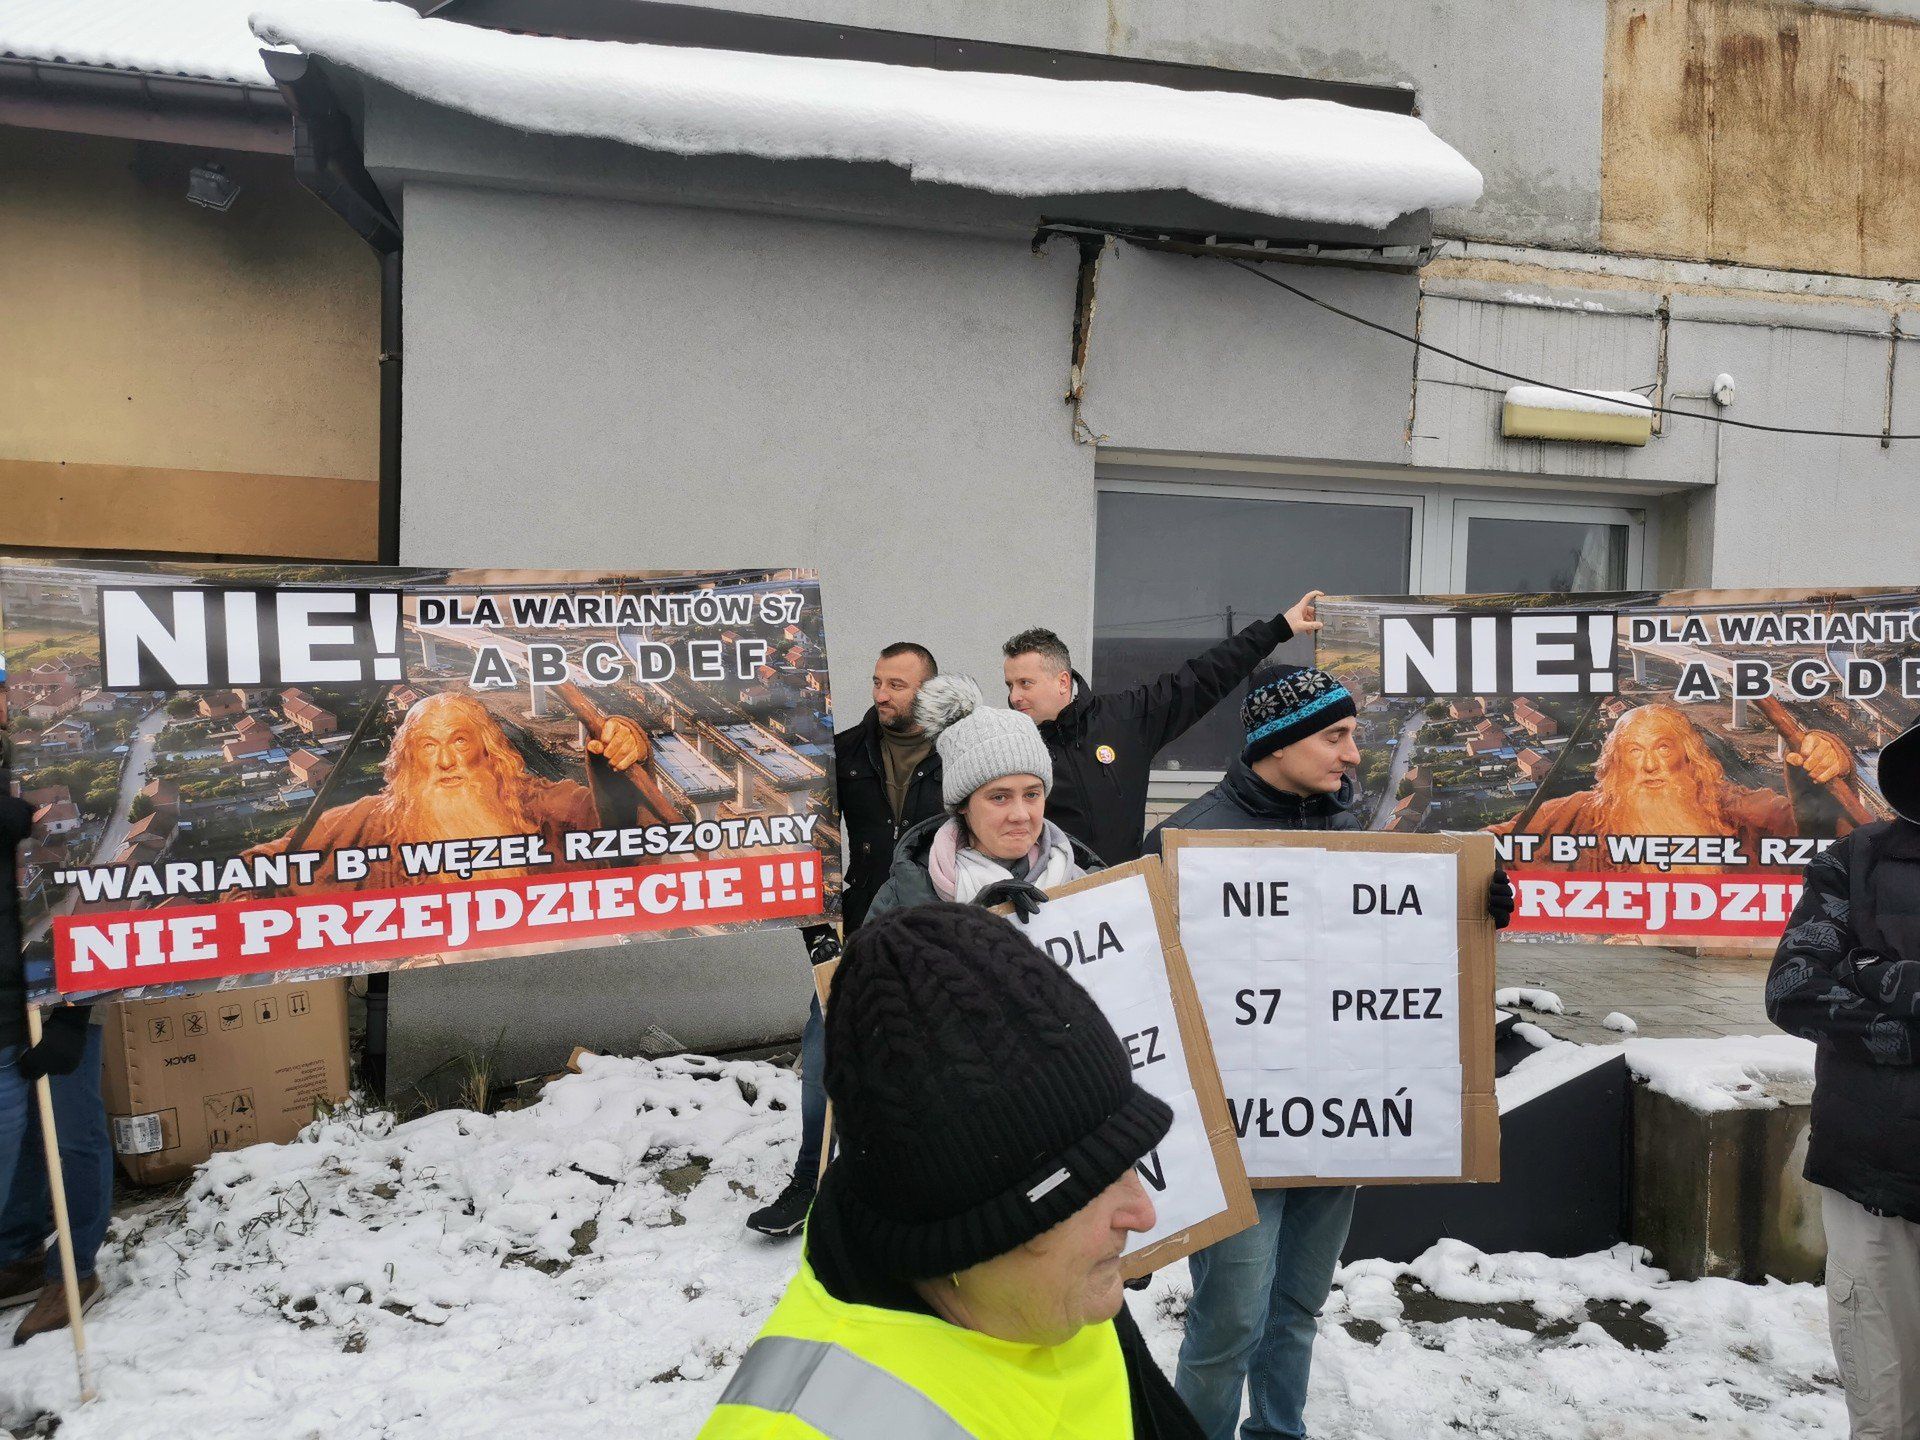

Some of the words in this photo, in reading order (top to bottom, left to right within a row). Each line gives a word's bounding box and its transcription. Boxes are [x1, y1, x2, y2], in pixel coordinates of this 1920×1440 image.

[416, 595, 504, 628] DLA
[511, 589, 752, 628] WARIANTÓW
[760, 593, 804, 626] S7
[1630, 616, 1711, 646] DLA
[103, 591, 401, 686] NIE!
[1385, 615, 1613, 694] NIE!
[470, 643, 517, 690] A
[528, 643, 569, 687] B
[582, 641, 624, 686] C
[636, 641, 676, 684] D
[688, 640, 725, 681] E
[737, 639, 768, 680] F
[1674, 661, 1720, 700] A
[1733, 660, 1774, 700] B
[1788, 659, 1830, 700] C
[1844, 658, 1887, 699] D
[54, 853, 321, 901] "WARIANT
[336, 847, 388, 880] B"
[402, 836, 551, 878] WĘZEŁ
[565, 816, 819, 861] RZESZOTARY
[1553, 835, 1597, 862] B"
[1608, 836, 1748, 869] WĘZEŁ
[70, 915, 218, 973] NIE
[239, 866, 743, 956] PRZEJDZIECIE
[759, 860, 816, 903] !!!
[1222, 881, 1290, 917] NIE
[1352, 883, 1423, 916] DLA
[1507, 875, 1803, 931] RZEJDZI
[1044, 921, 1125, 970] DLA
[1234, 988, 1282, 1026] S7
[1331, 988, 1444, 1023] PRZEZ
[164, 1053, 197, 1068] BACK
